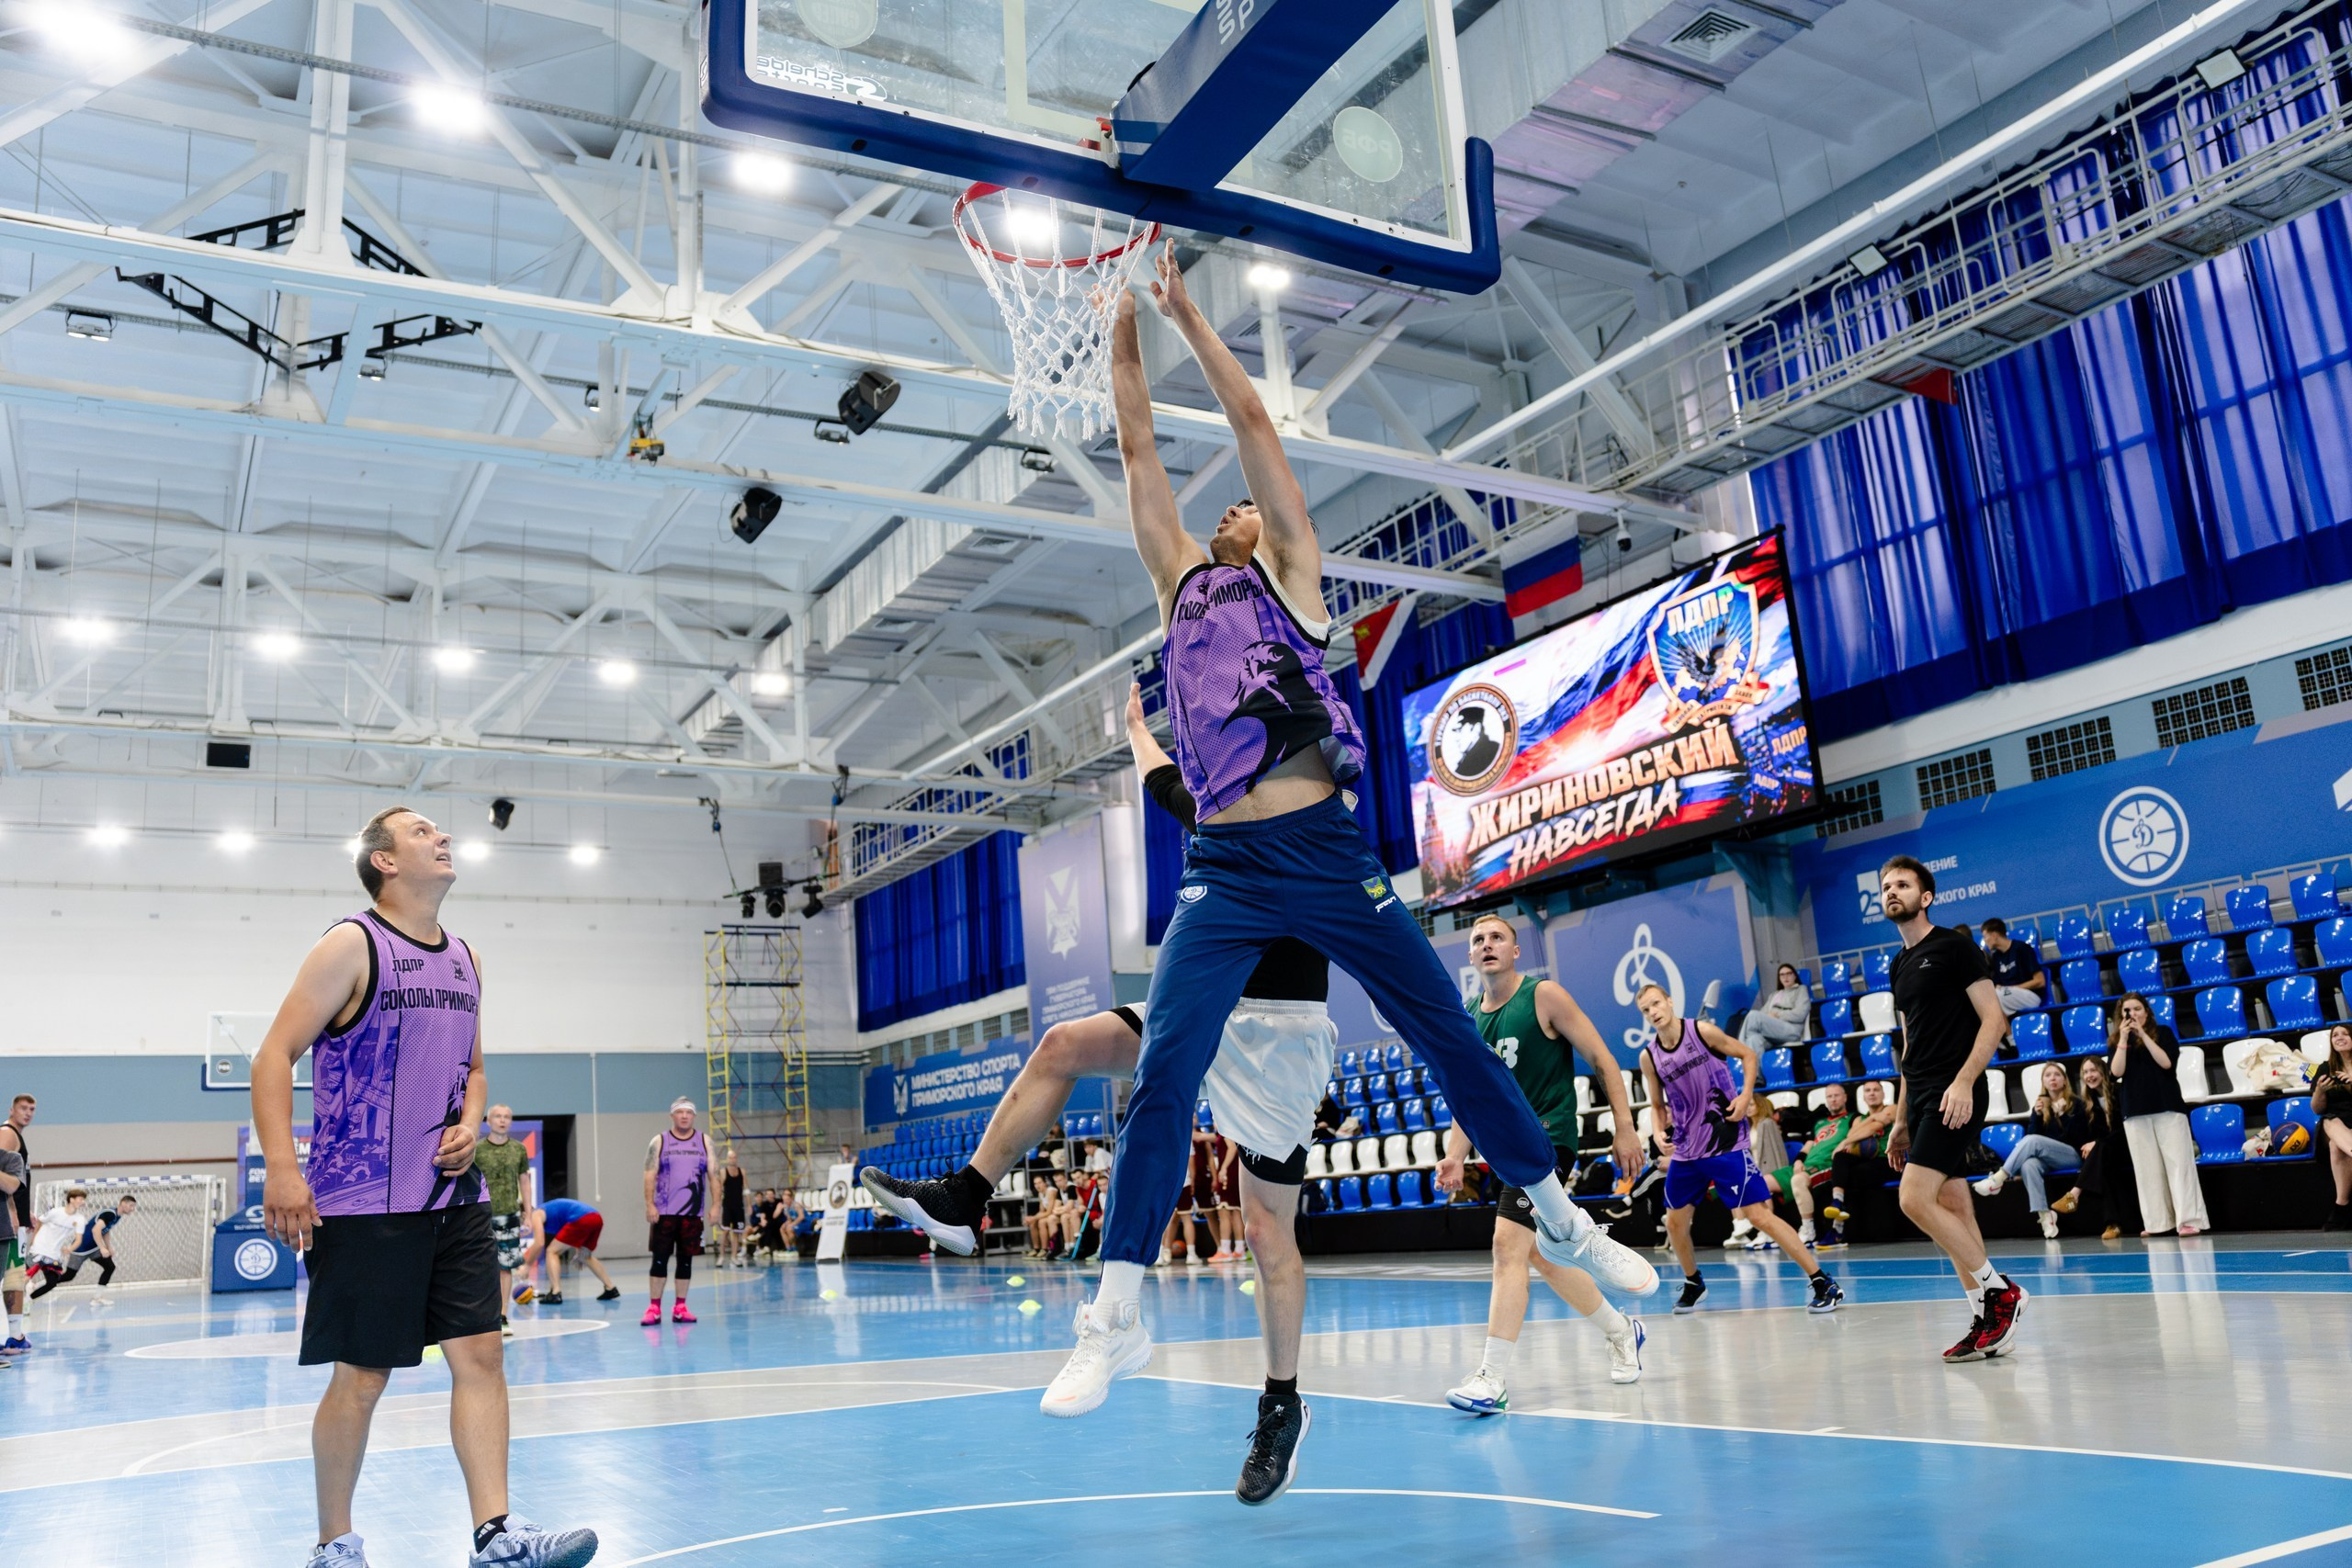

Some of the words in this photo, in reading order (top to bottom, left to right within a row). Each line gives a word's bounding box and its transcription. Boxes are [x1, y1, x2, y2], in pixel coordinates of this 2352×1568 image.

[1666, 586, 1735, 637] ЛДПР
[1771, 726, 1807, 756] ЛДПР
[1465, 717, 1739, 854] ЖИРИНОВСКИЙ
[1507, 777, 1681, 882] НАВСЕГДА
[1968, 880, 1996, 898] КРАЯ
[392, 959, 424, 973] ЛДПР
[379, 987, 435, 1011] СОКОЛЫ
[910, 1062, 981, 1090] МИНИСТЕРСТВО
[982, 1053, 1022, 1076] СПОРТА
[911, 1081, 976, 1107] ПРИМОРСКОГО
[976, 1076, 1004, 1096] КРАЯ
